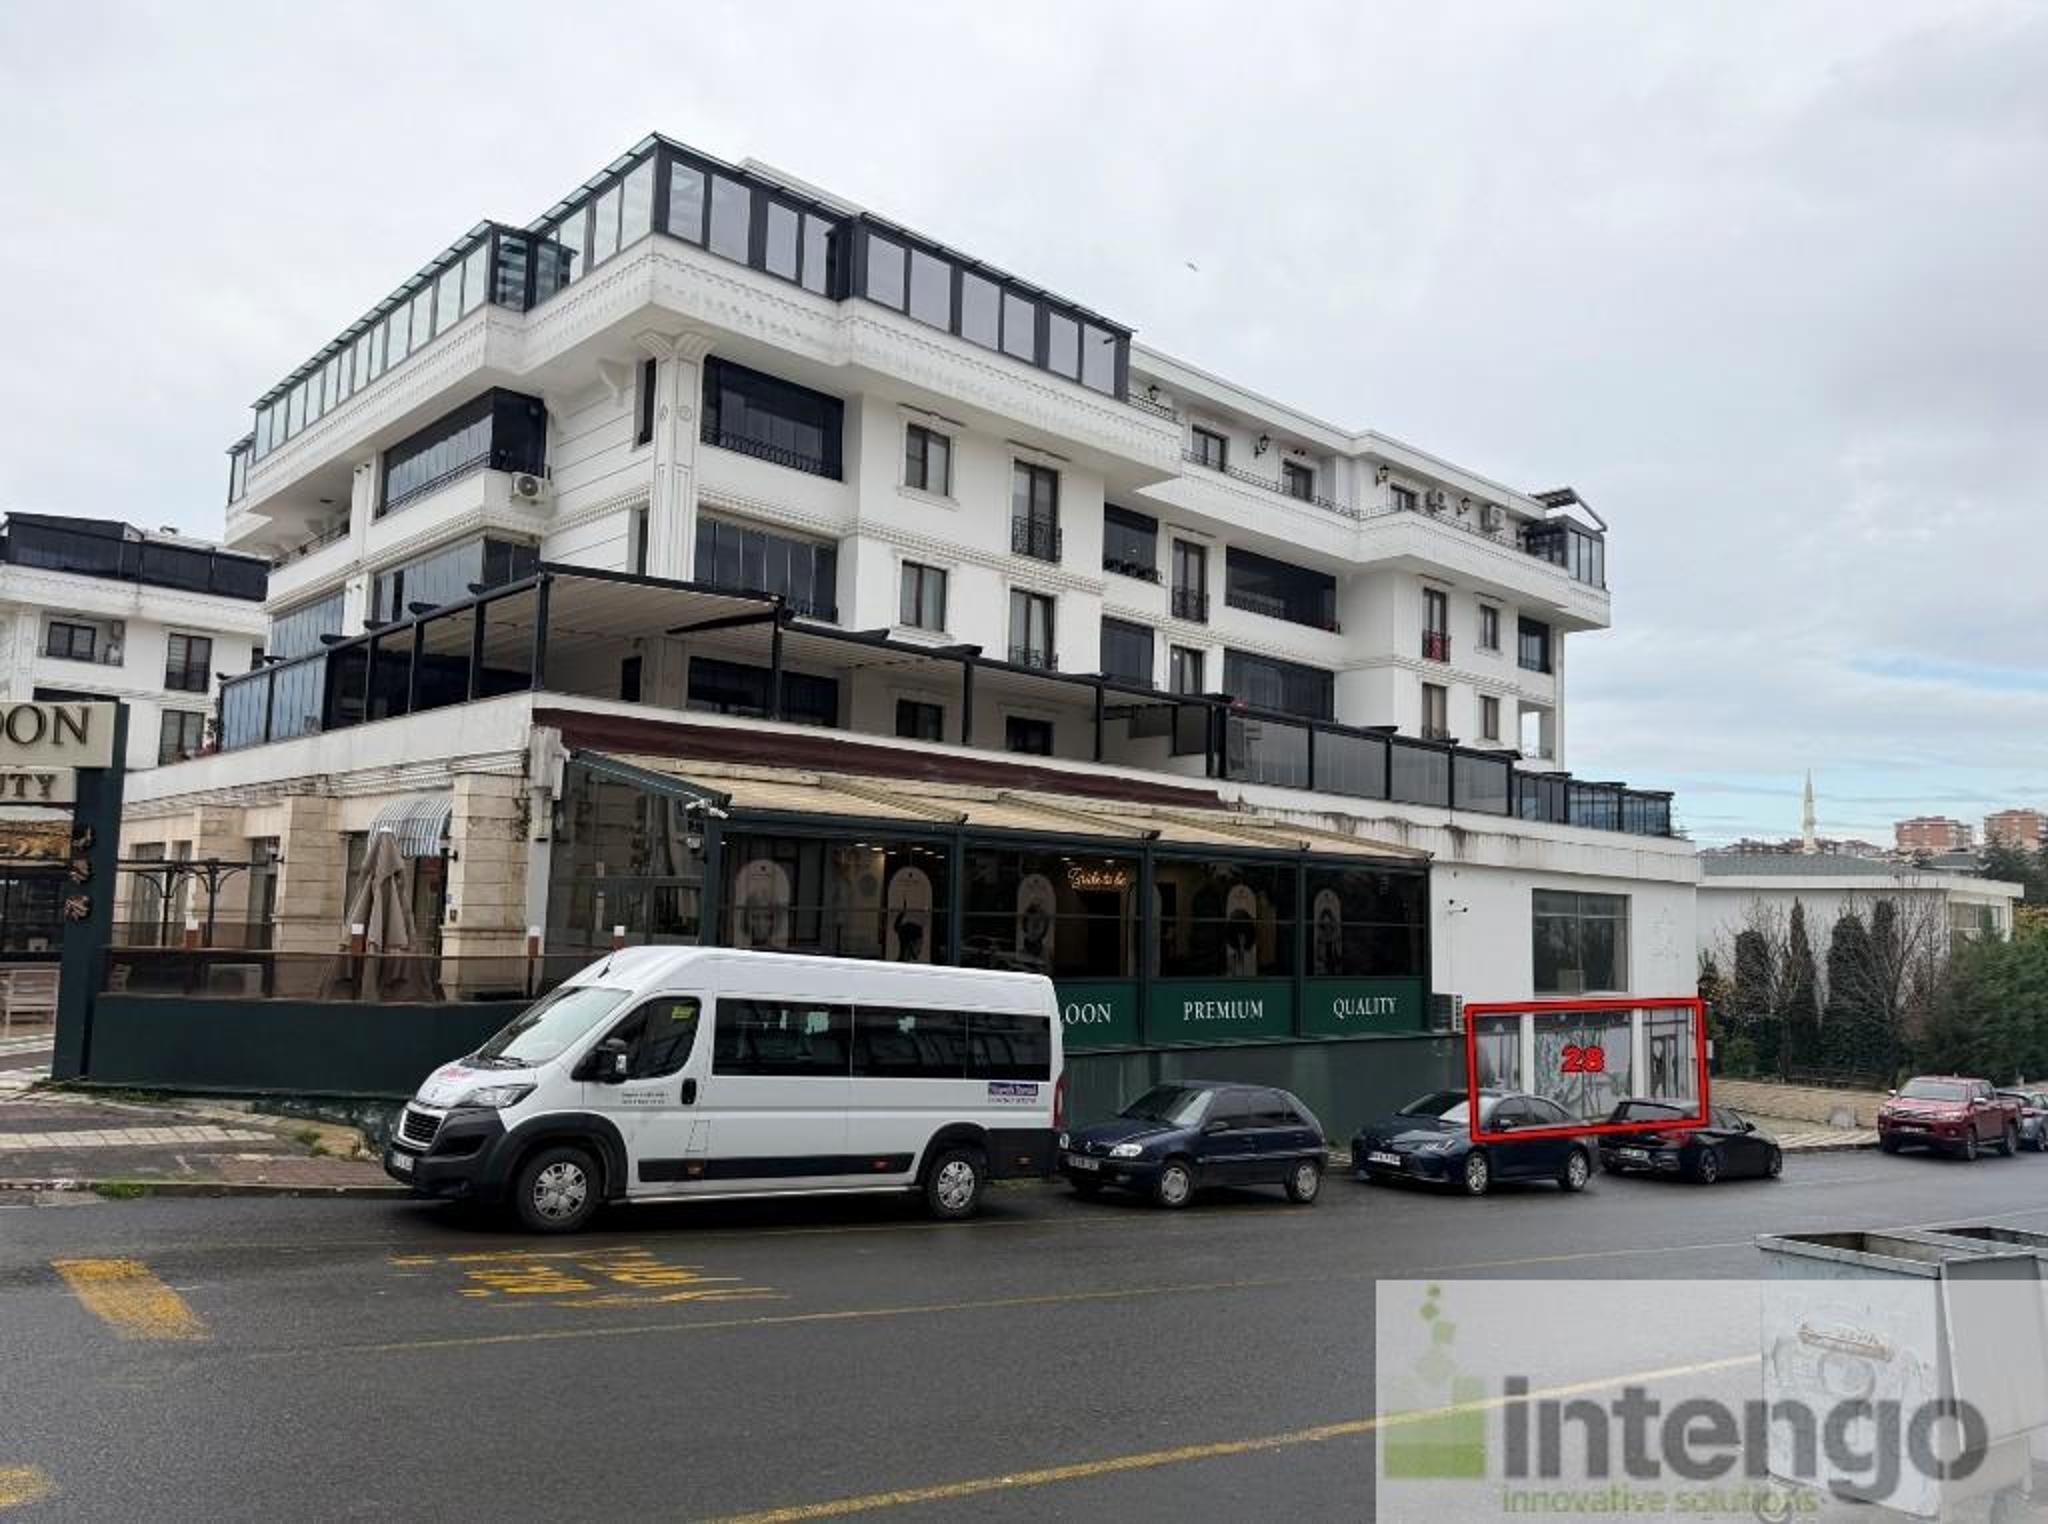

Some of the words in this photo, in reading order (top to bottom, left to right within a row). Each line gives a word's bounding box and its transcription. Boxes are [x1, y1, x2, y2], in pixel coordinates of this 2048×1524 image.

[0, 704, 90, 746] ON
[0, 773, 57, 798] TY
[1060, 1003, 1112, 1025] OON
[1183, 1000, 1263, 1021] PREMIUM
[1333, 997, 1397, 1018] QUALITY
